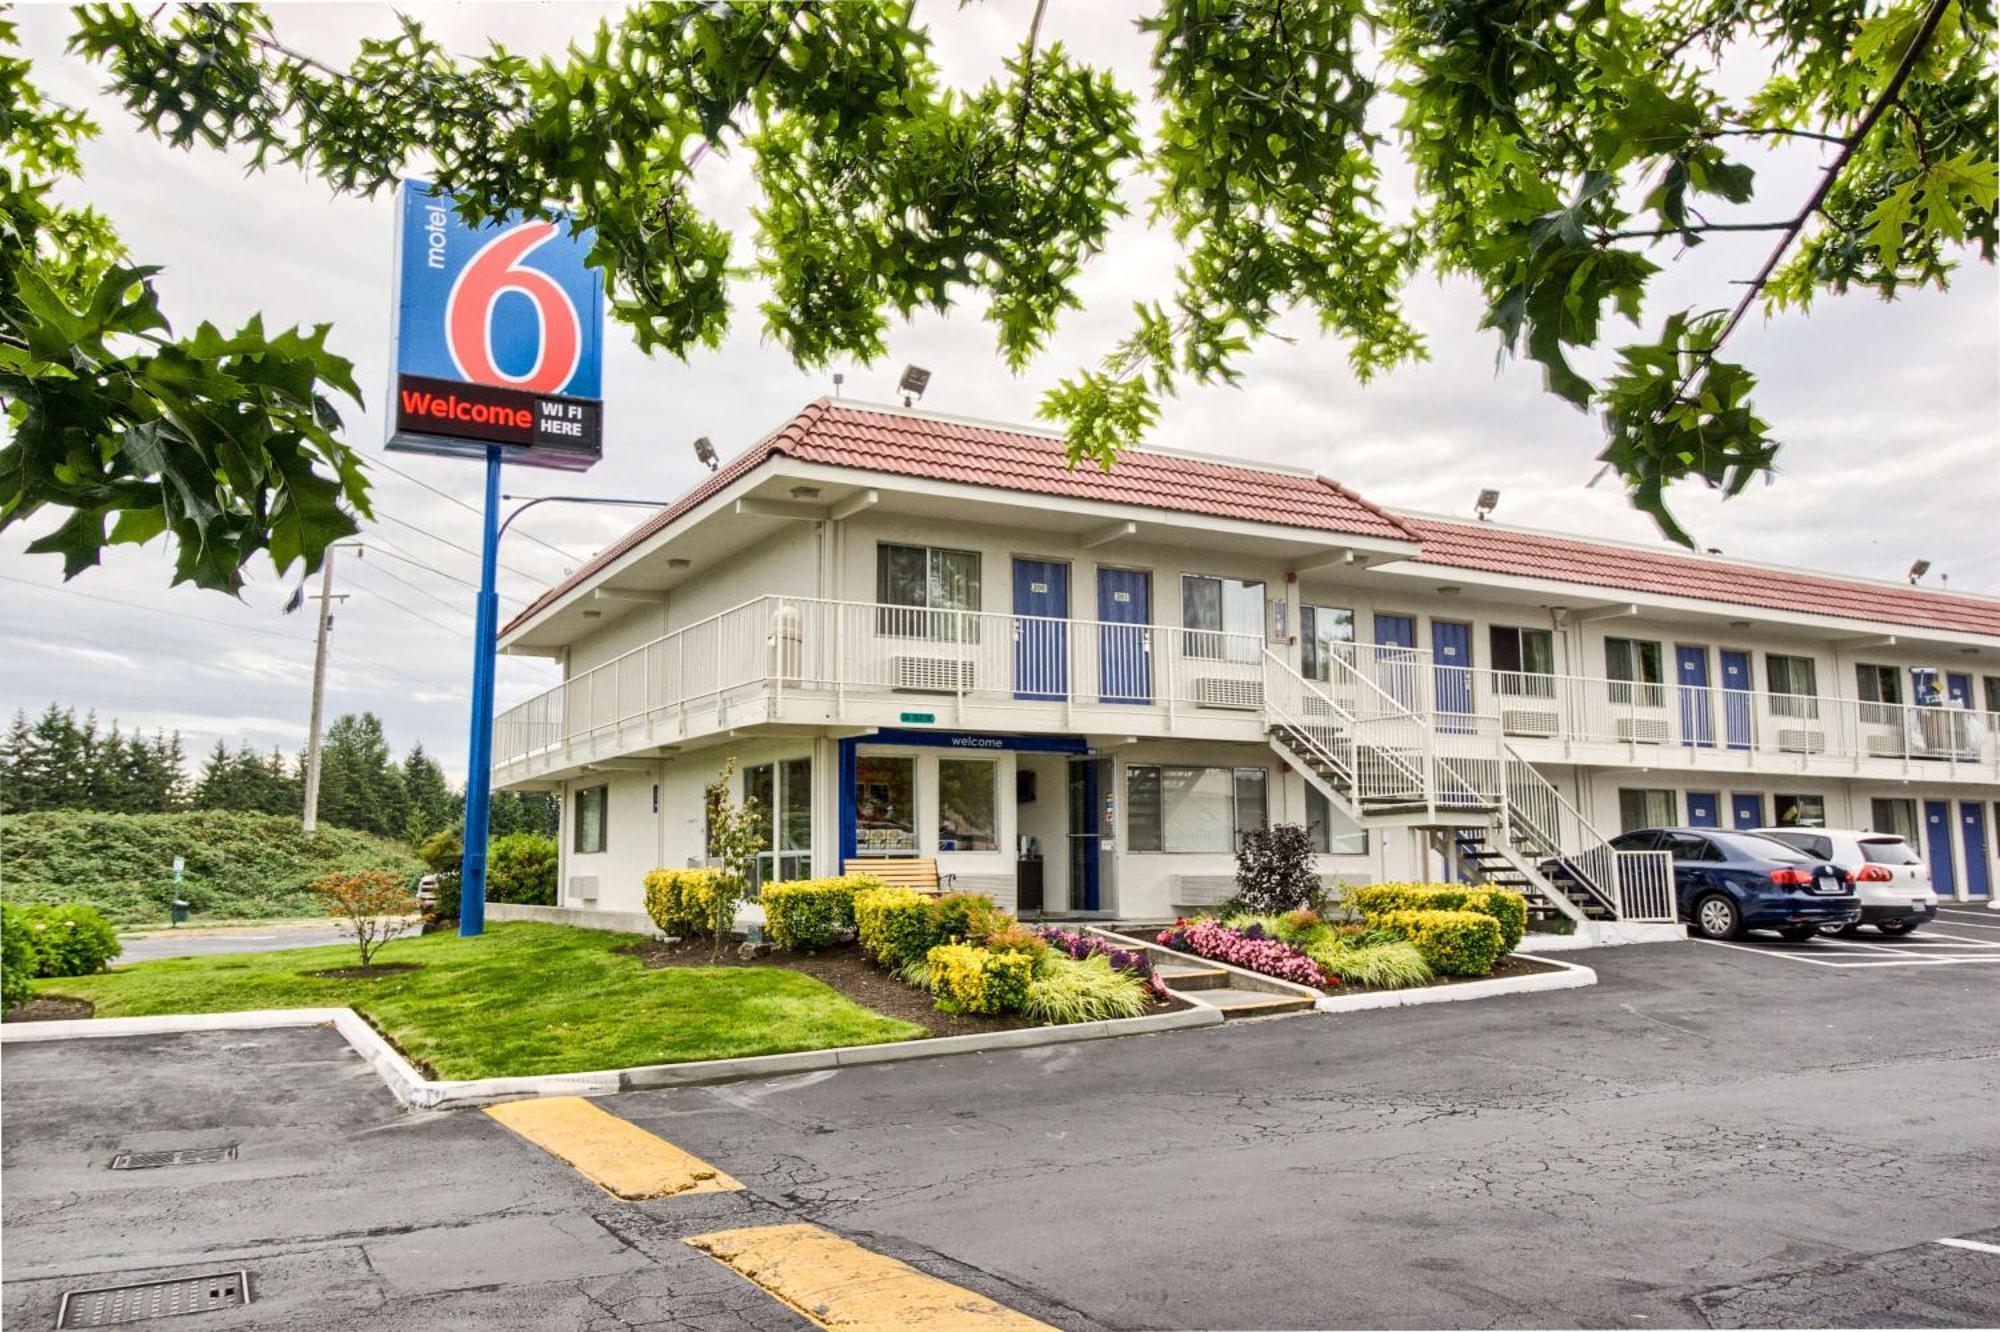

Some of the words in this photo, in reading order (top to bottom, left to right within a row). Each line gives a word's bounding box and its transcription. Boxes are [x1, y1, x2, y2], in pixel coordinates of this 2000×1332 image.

[426, 205, 447, 269] motel
[444, 220, 582, 394] 6
[402, 391, 532, 428] Welcome
[542, 402, 563, 418] WI
[568, 406, 582, 420] FI
[540, 419, 582, 437] HERE
[951, 736, 1003, 748] welcome
